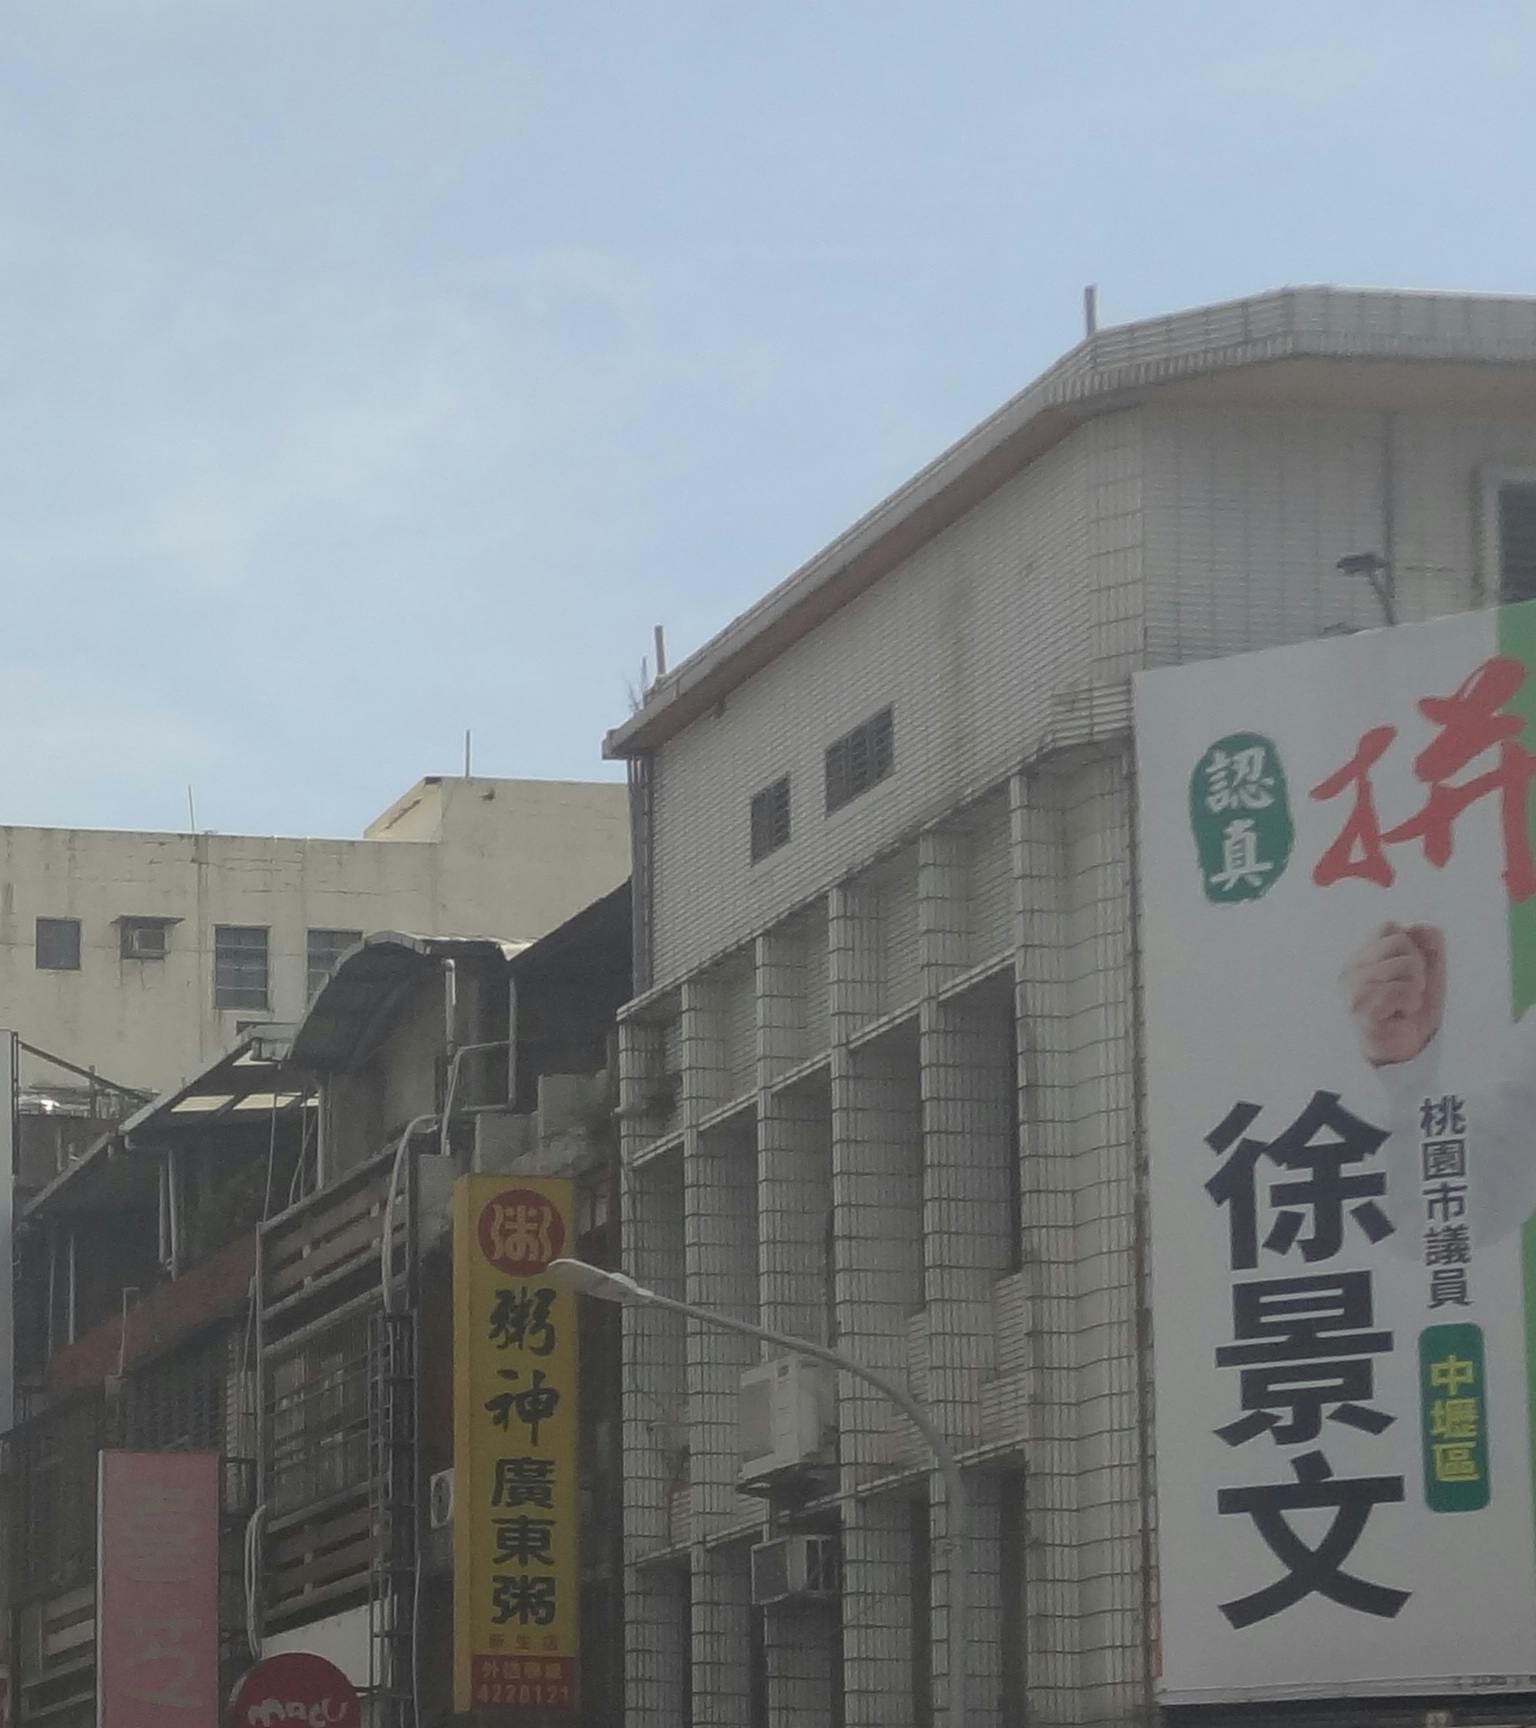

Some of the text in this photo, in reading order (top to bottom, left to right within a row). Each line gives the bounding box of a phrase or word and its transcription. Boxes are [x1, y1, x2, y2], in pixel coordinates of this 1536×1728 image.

[1203, 744, 1276, 892] 認真
[1419, 1095, 1473, 1310] 桃園市議員
[1202, 1089, 1413, 1629] 徐景文
[1427, 1354, 1480, 1484] 中壢區
